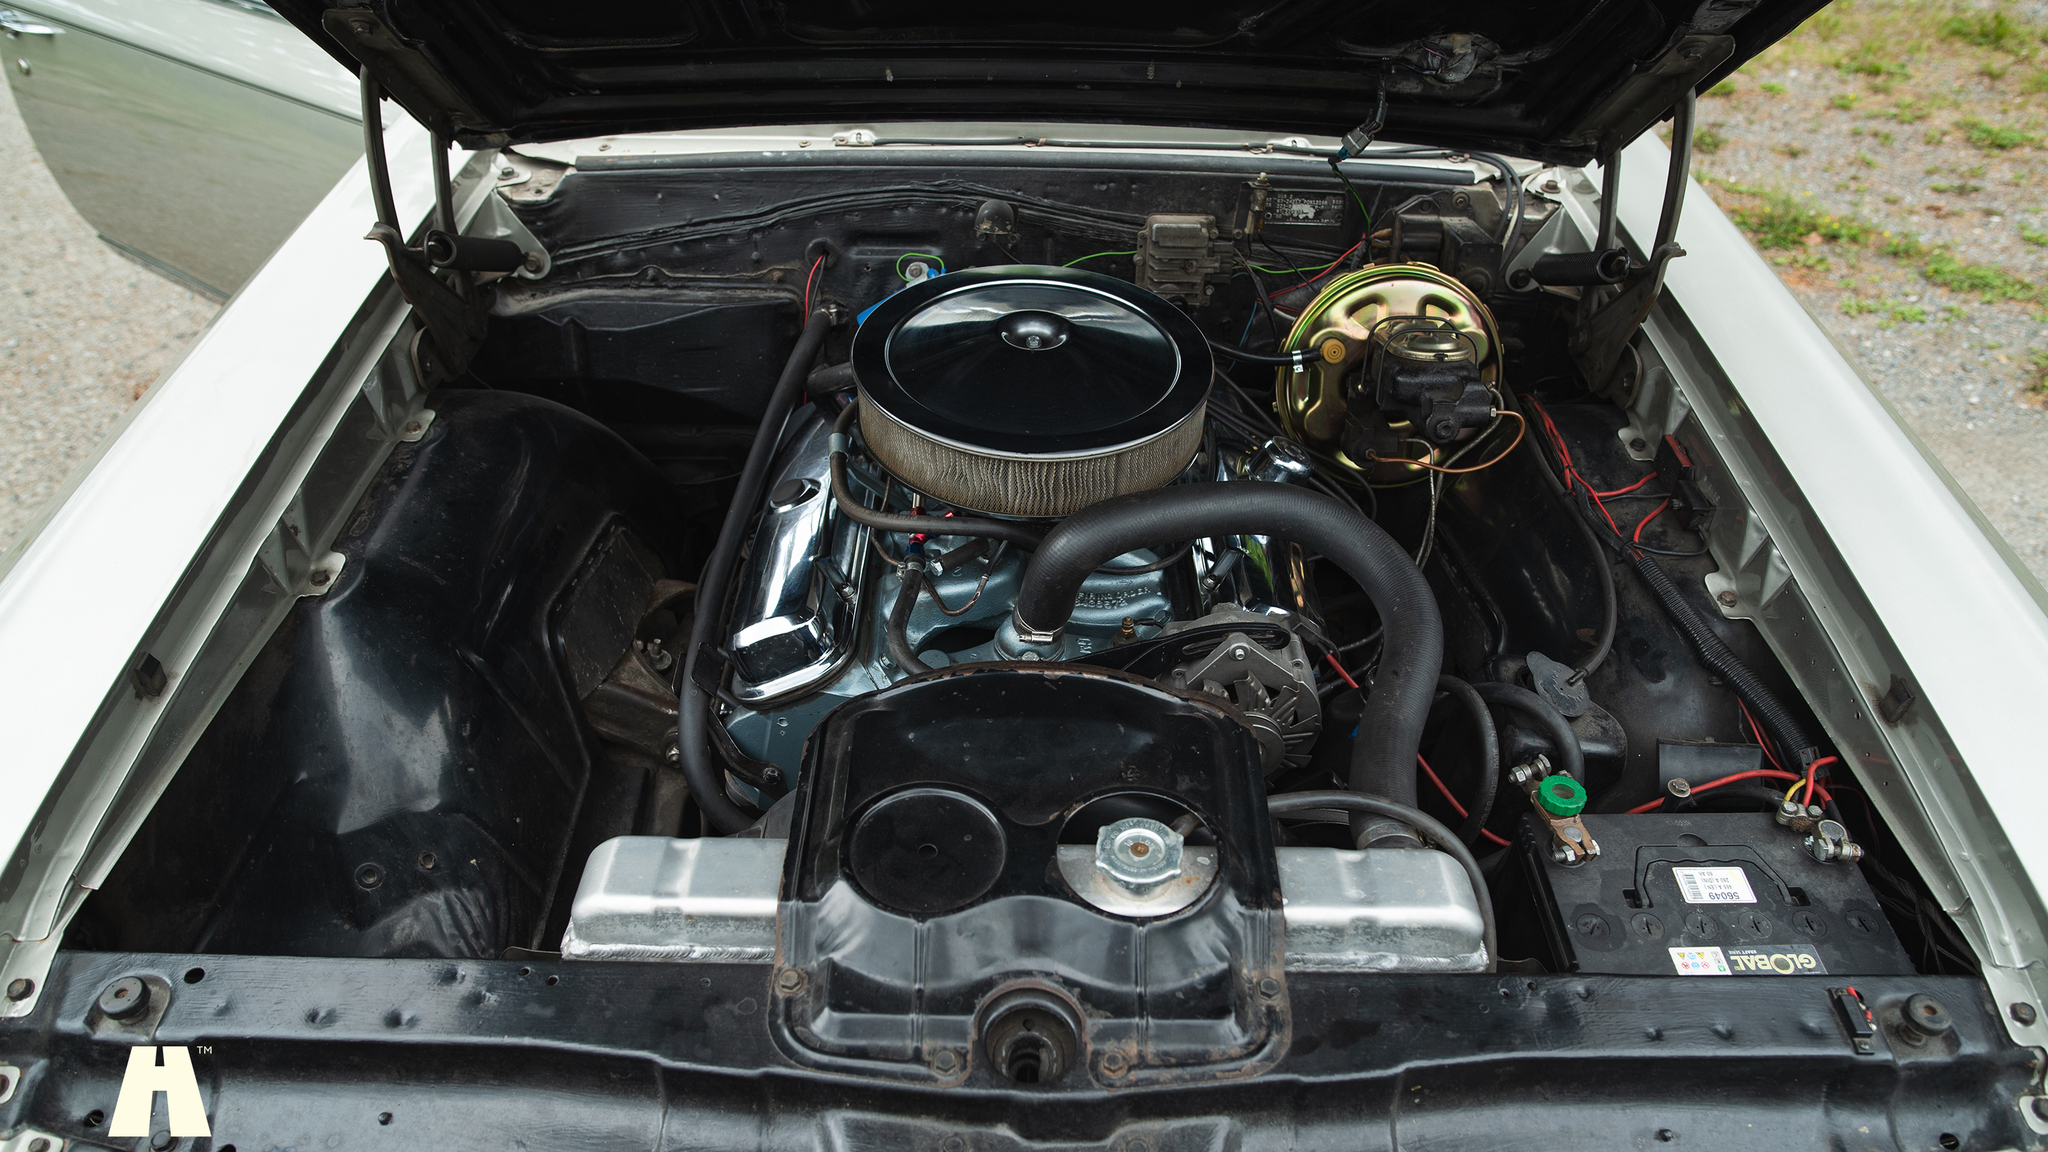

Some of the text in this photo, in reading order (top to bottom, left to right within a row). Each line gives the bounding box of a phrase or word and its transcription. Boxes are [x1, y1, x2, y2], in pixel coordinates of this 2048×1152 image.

[1491, 730, 1498, 740] IN
[1489, 774, 1498, 796] HOSE
[1709, 892, 1740, 900] 56049
[1730, 954, 1816, 974] GLOBAL
